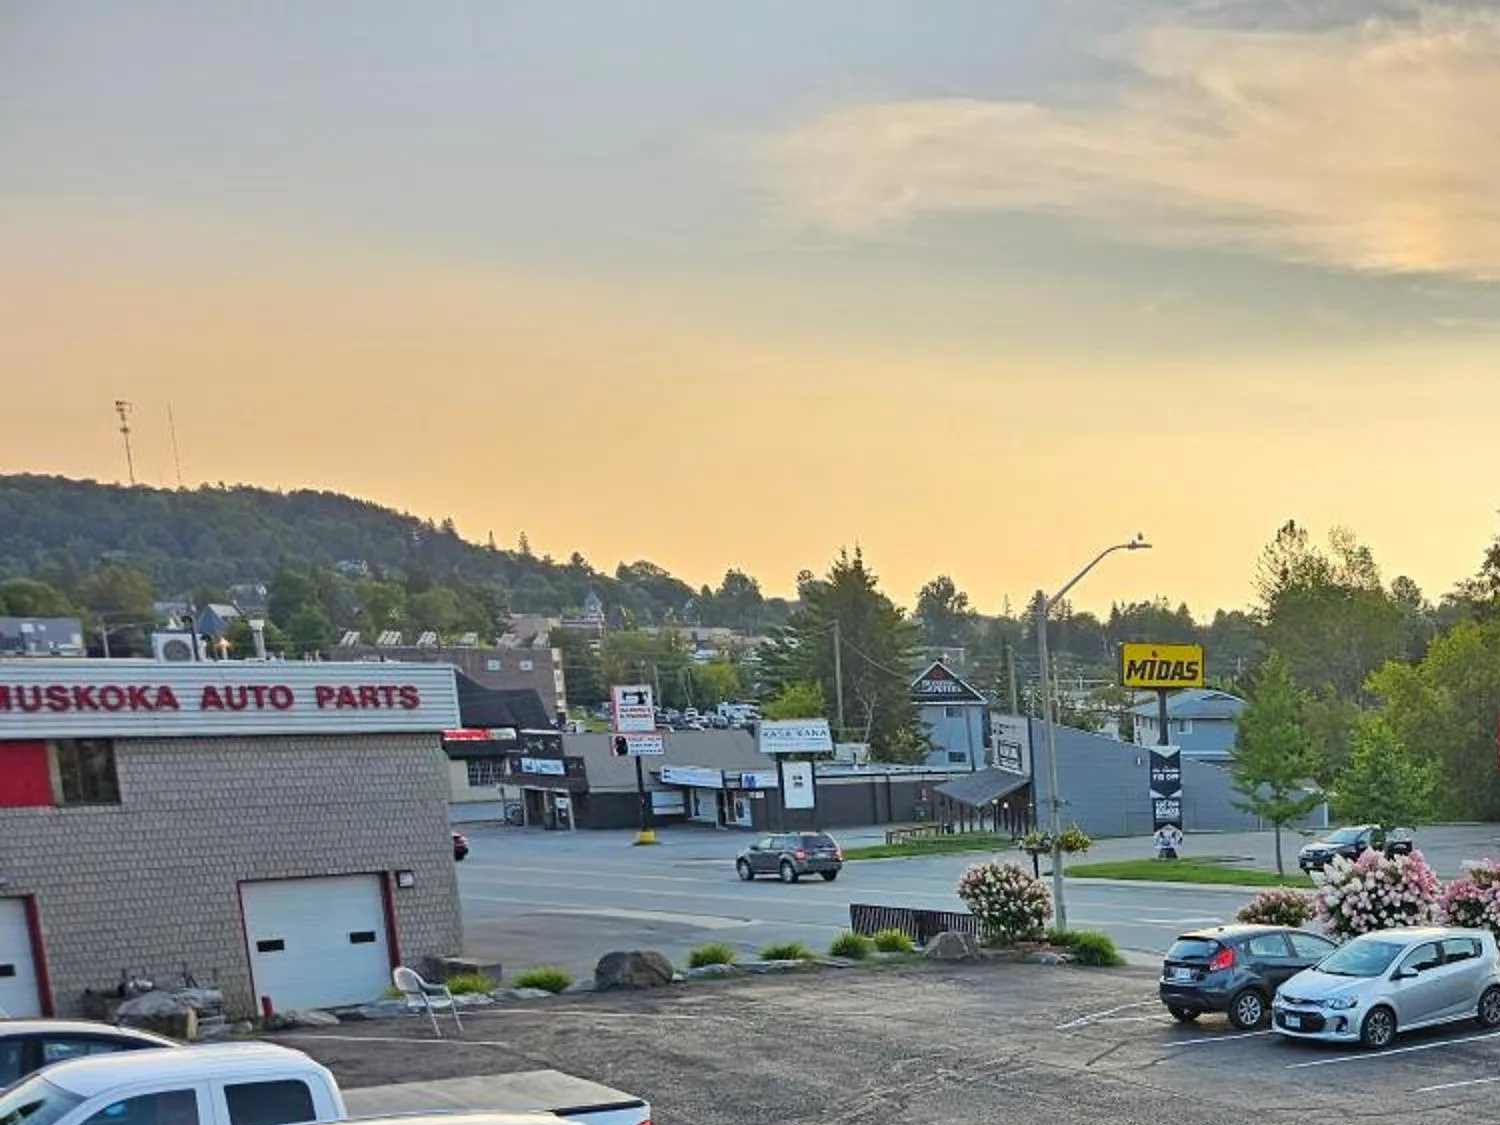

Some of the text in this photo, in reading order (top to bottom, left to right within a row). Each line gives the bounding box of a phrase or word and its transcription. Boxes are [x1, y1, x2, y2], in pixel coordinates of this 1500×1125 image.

[1126, 658, 1199, 681] MIDAS
[200, 685, 295, 712] AUTO
[315, 685, 421, 711] PARTS
